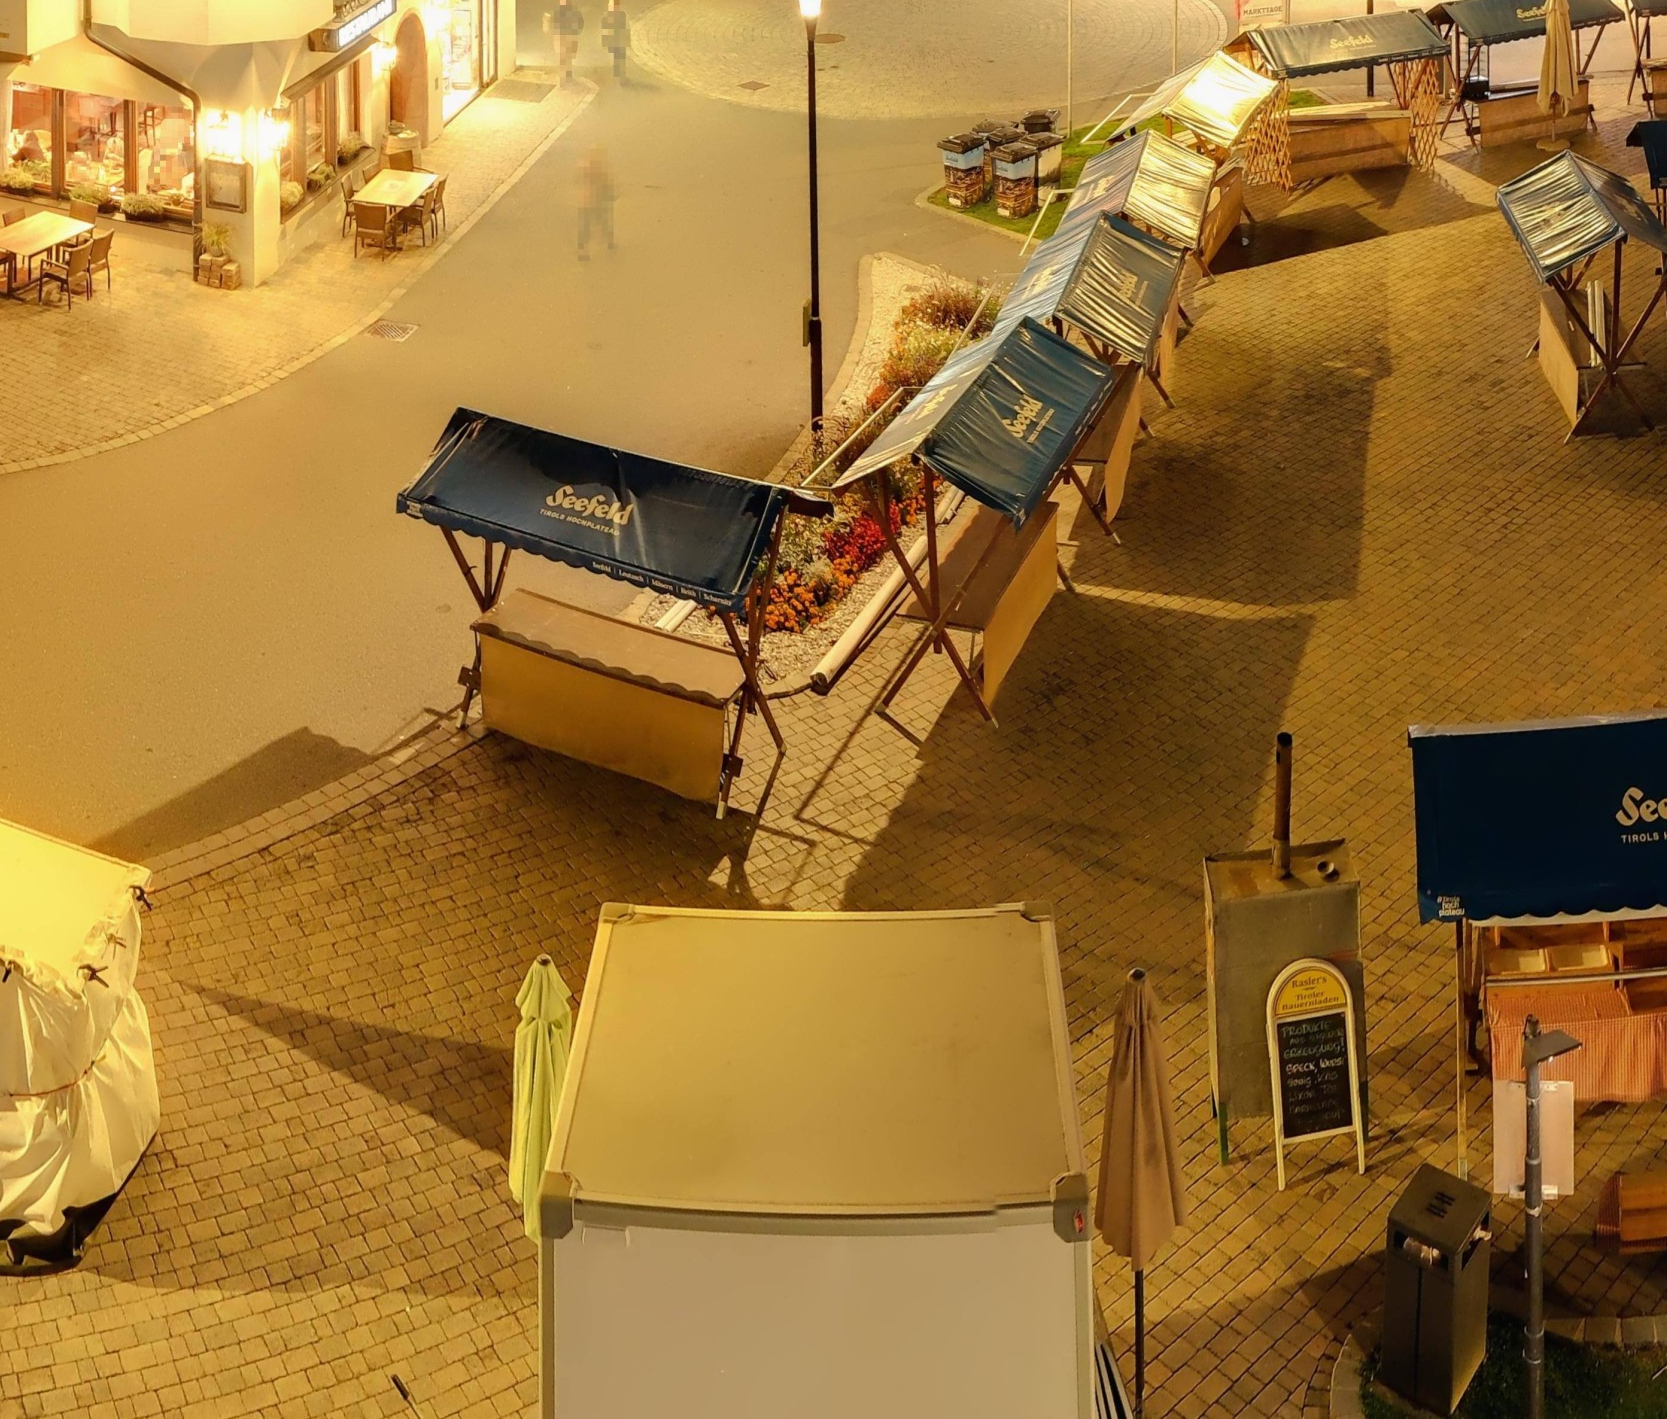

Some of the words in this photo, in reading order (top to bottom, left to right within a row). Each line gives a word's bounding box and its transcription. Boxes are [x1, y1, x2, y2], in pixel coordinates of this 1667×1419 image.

[1243, 4, 1284, 16] MARKTTAGE
[1329, 34, 1374, 49] Seefeld
[545, 484, 634, 526] Seefeld
[540, 507, 566, 521] TIROLS
[567, 514, 620, 536] HOCHPLATEAU
[1620, 830, 1660, 844] TIROLS
[1291, 975, 1328, 989] Rasler's
[1294, 990, 1325, 1001] Tiroler
[1282, 995, 1340, 1011] Bauernladen
